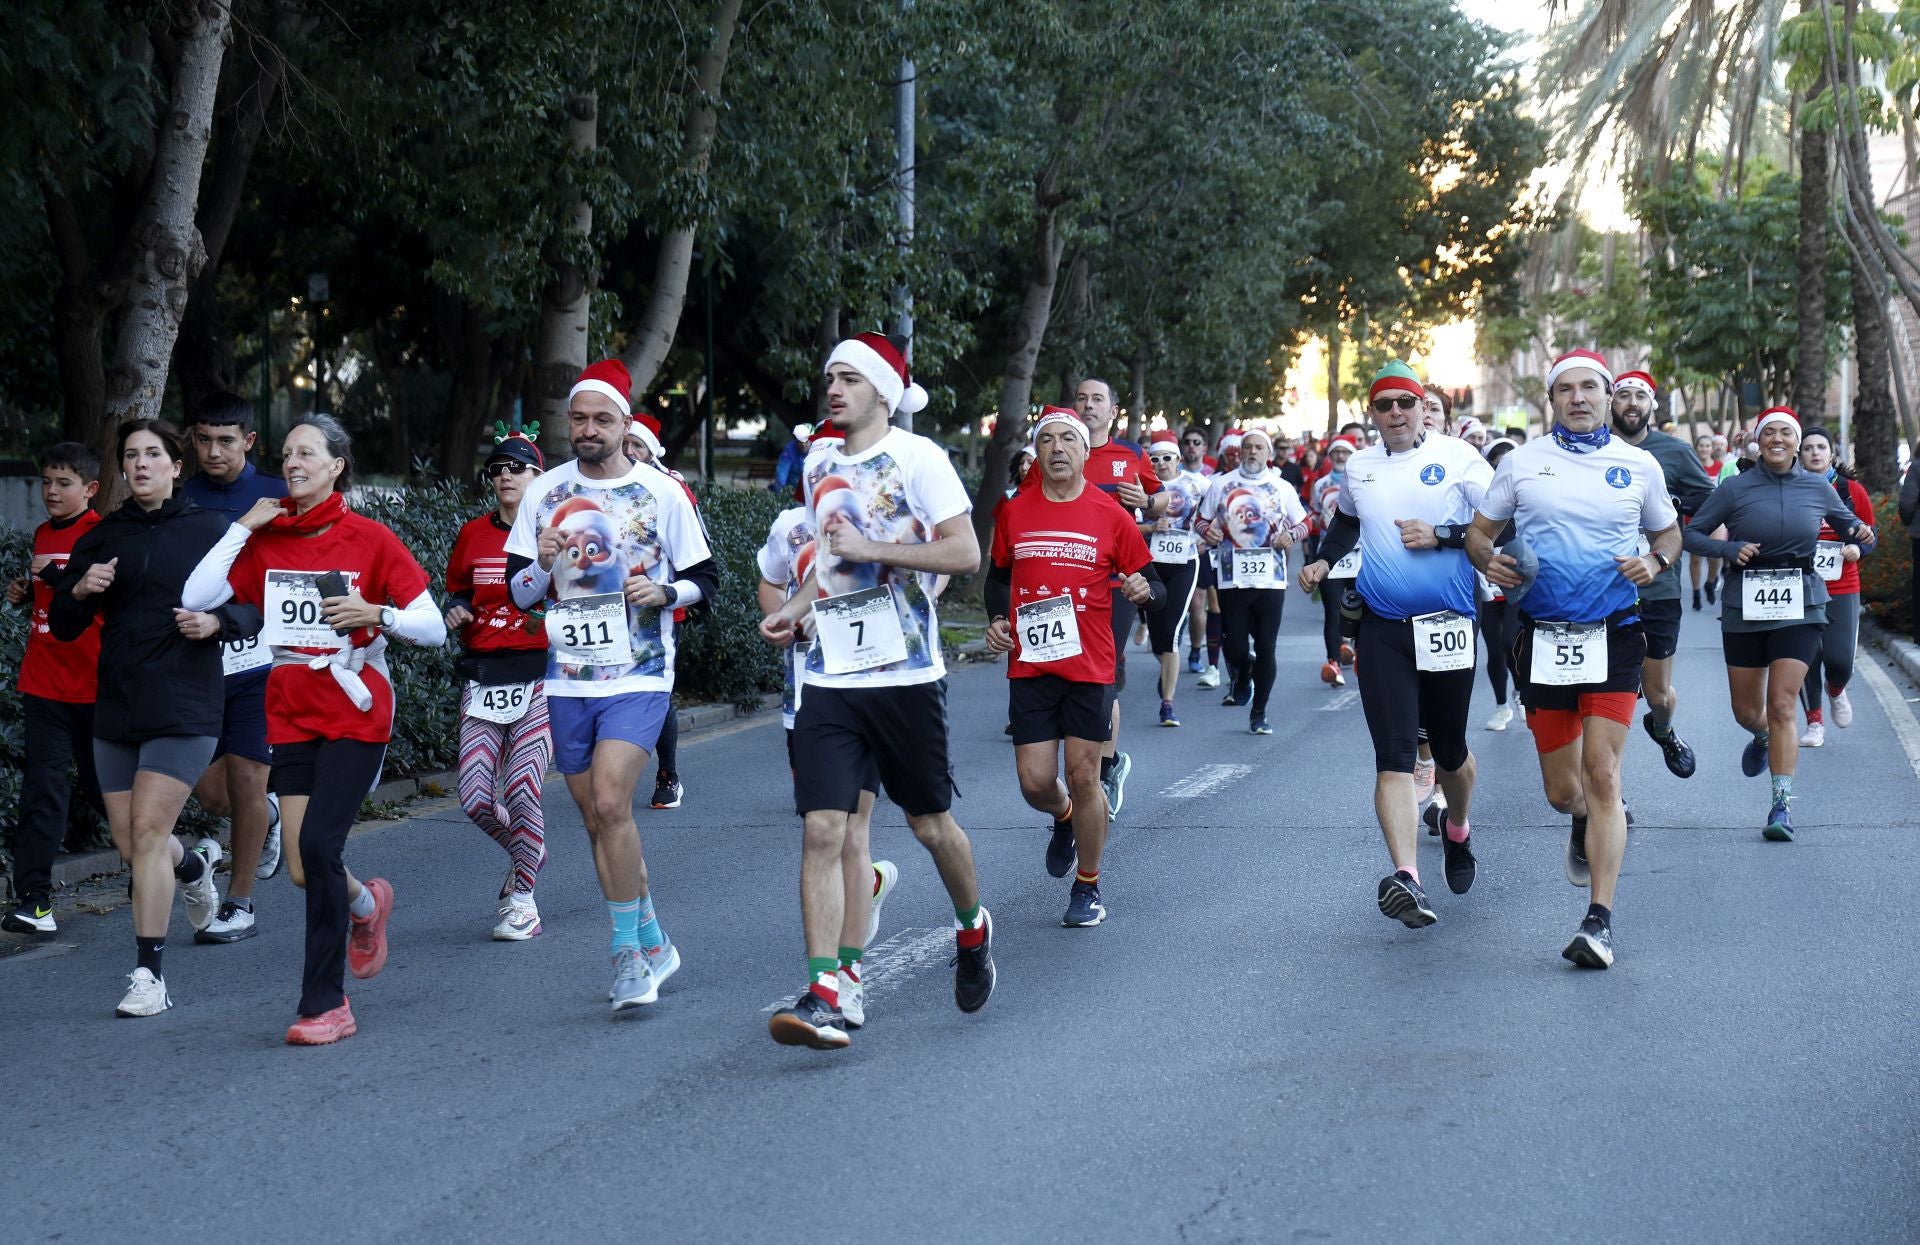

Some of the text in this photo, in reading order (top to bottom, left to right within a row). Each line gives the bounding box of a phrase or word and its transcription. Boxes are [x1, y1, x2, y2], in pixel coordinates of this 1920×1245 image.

[1031, 550, 1097, 564] PALMA PALMILLA
[1062, 541, 1098, 554] CARRERA
[1158, 540, 1183, 554] 506
[1240, 561, 1267, 574] 332
[1754, 588, 1793, 605] 444
[562, 620, 614, 647] 311
[849, 620, 864, 647] 7
[1026, 620, 1066, 647] 674
[1429, 629, 1467, 653] 500
[1555, 644, 1585, 666] 55
[483, 687, 523, 711] 436
